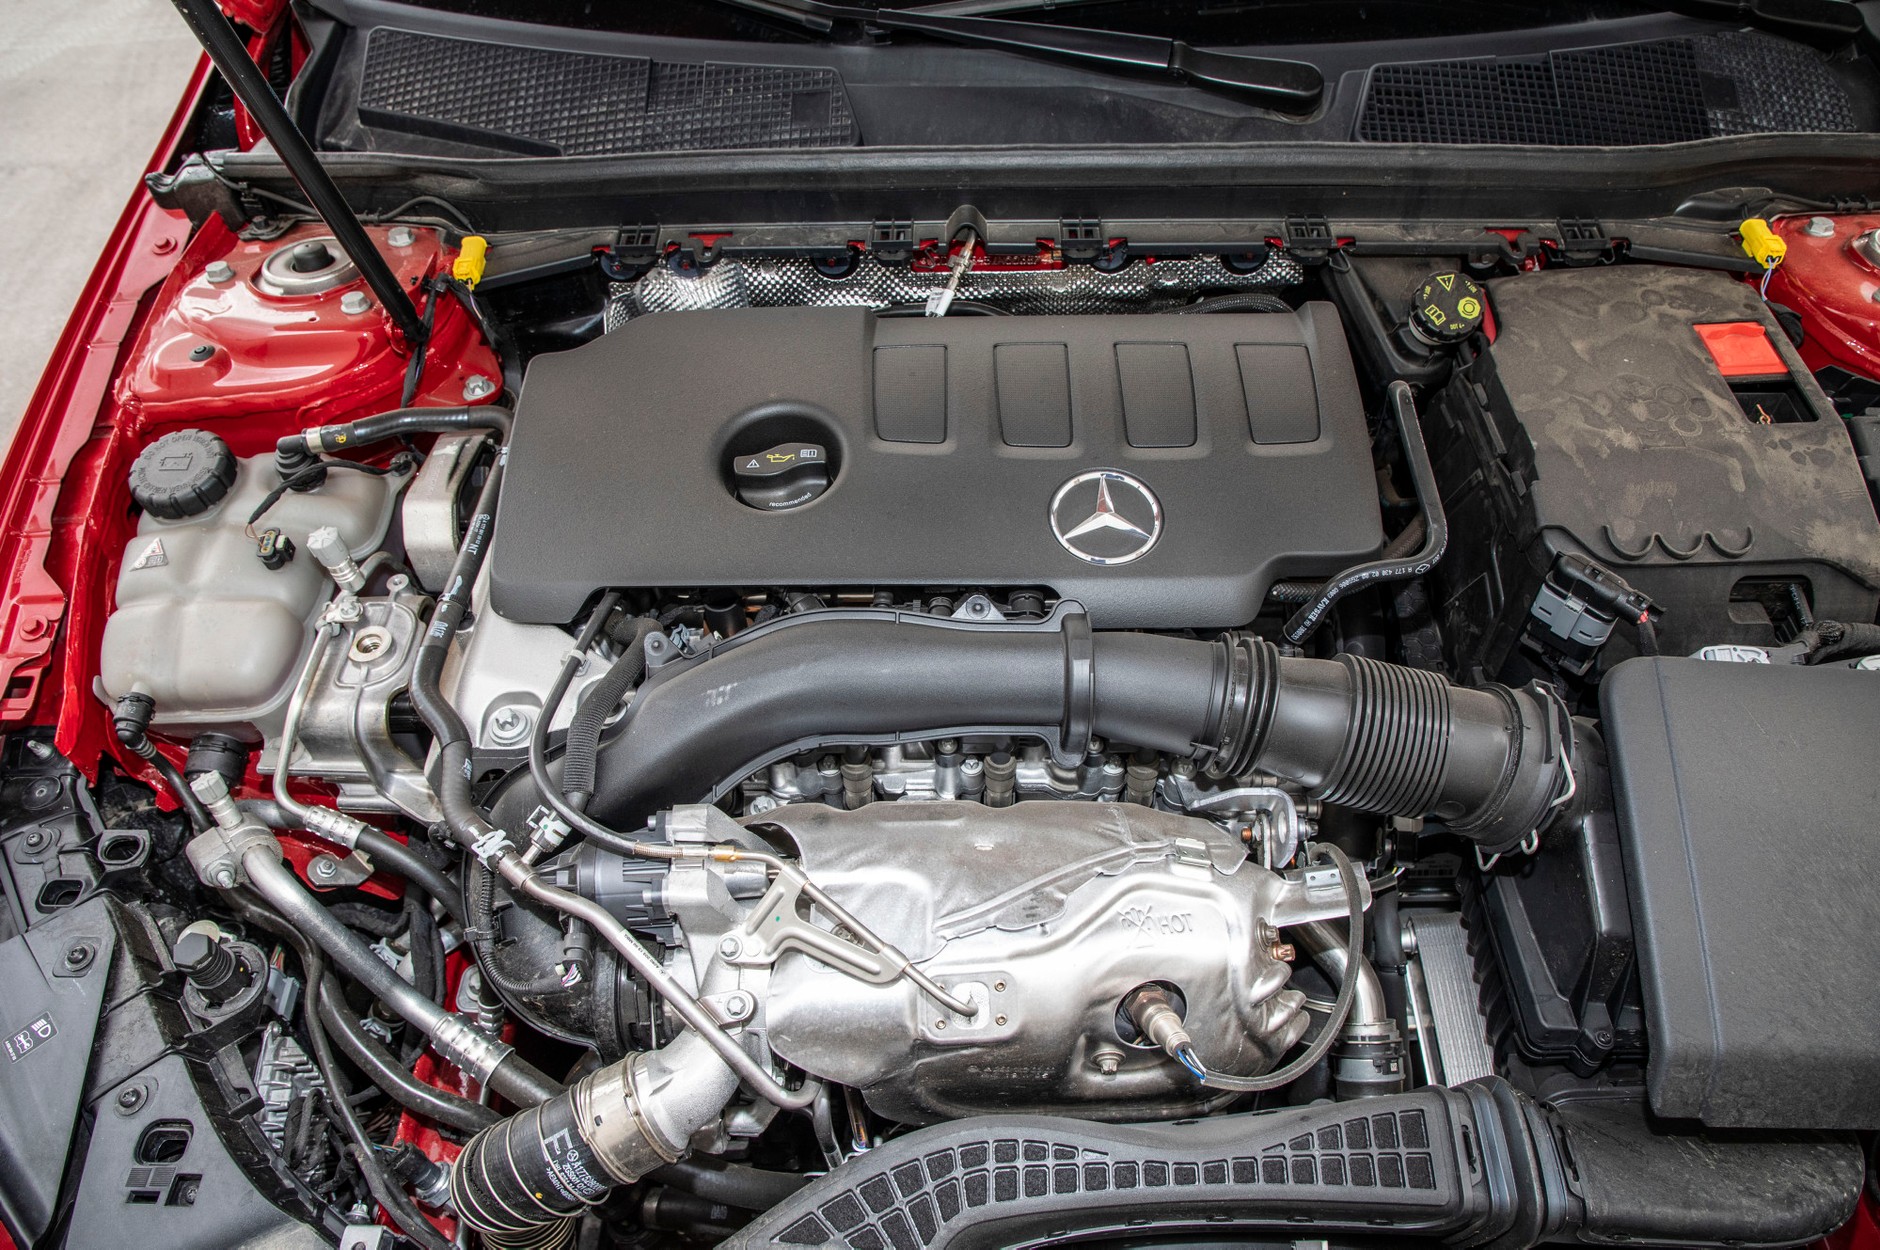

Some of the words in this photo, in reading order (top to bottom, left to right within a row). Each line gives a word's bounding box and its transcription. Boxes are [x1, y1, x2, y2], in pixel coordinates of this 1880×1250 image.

[154, 439, 169, 452] NOT
[171, 434, 192, 443] OPEN
[768, 492, 812, 507] recommended
[1308, 596, 1330, 622] KAYSER
[1158, 913, 1192, 934] HOT
[542, 1128, 574, 1162] E
